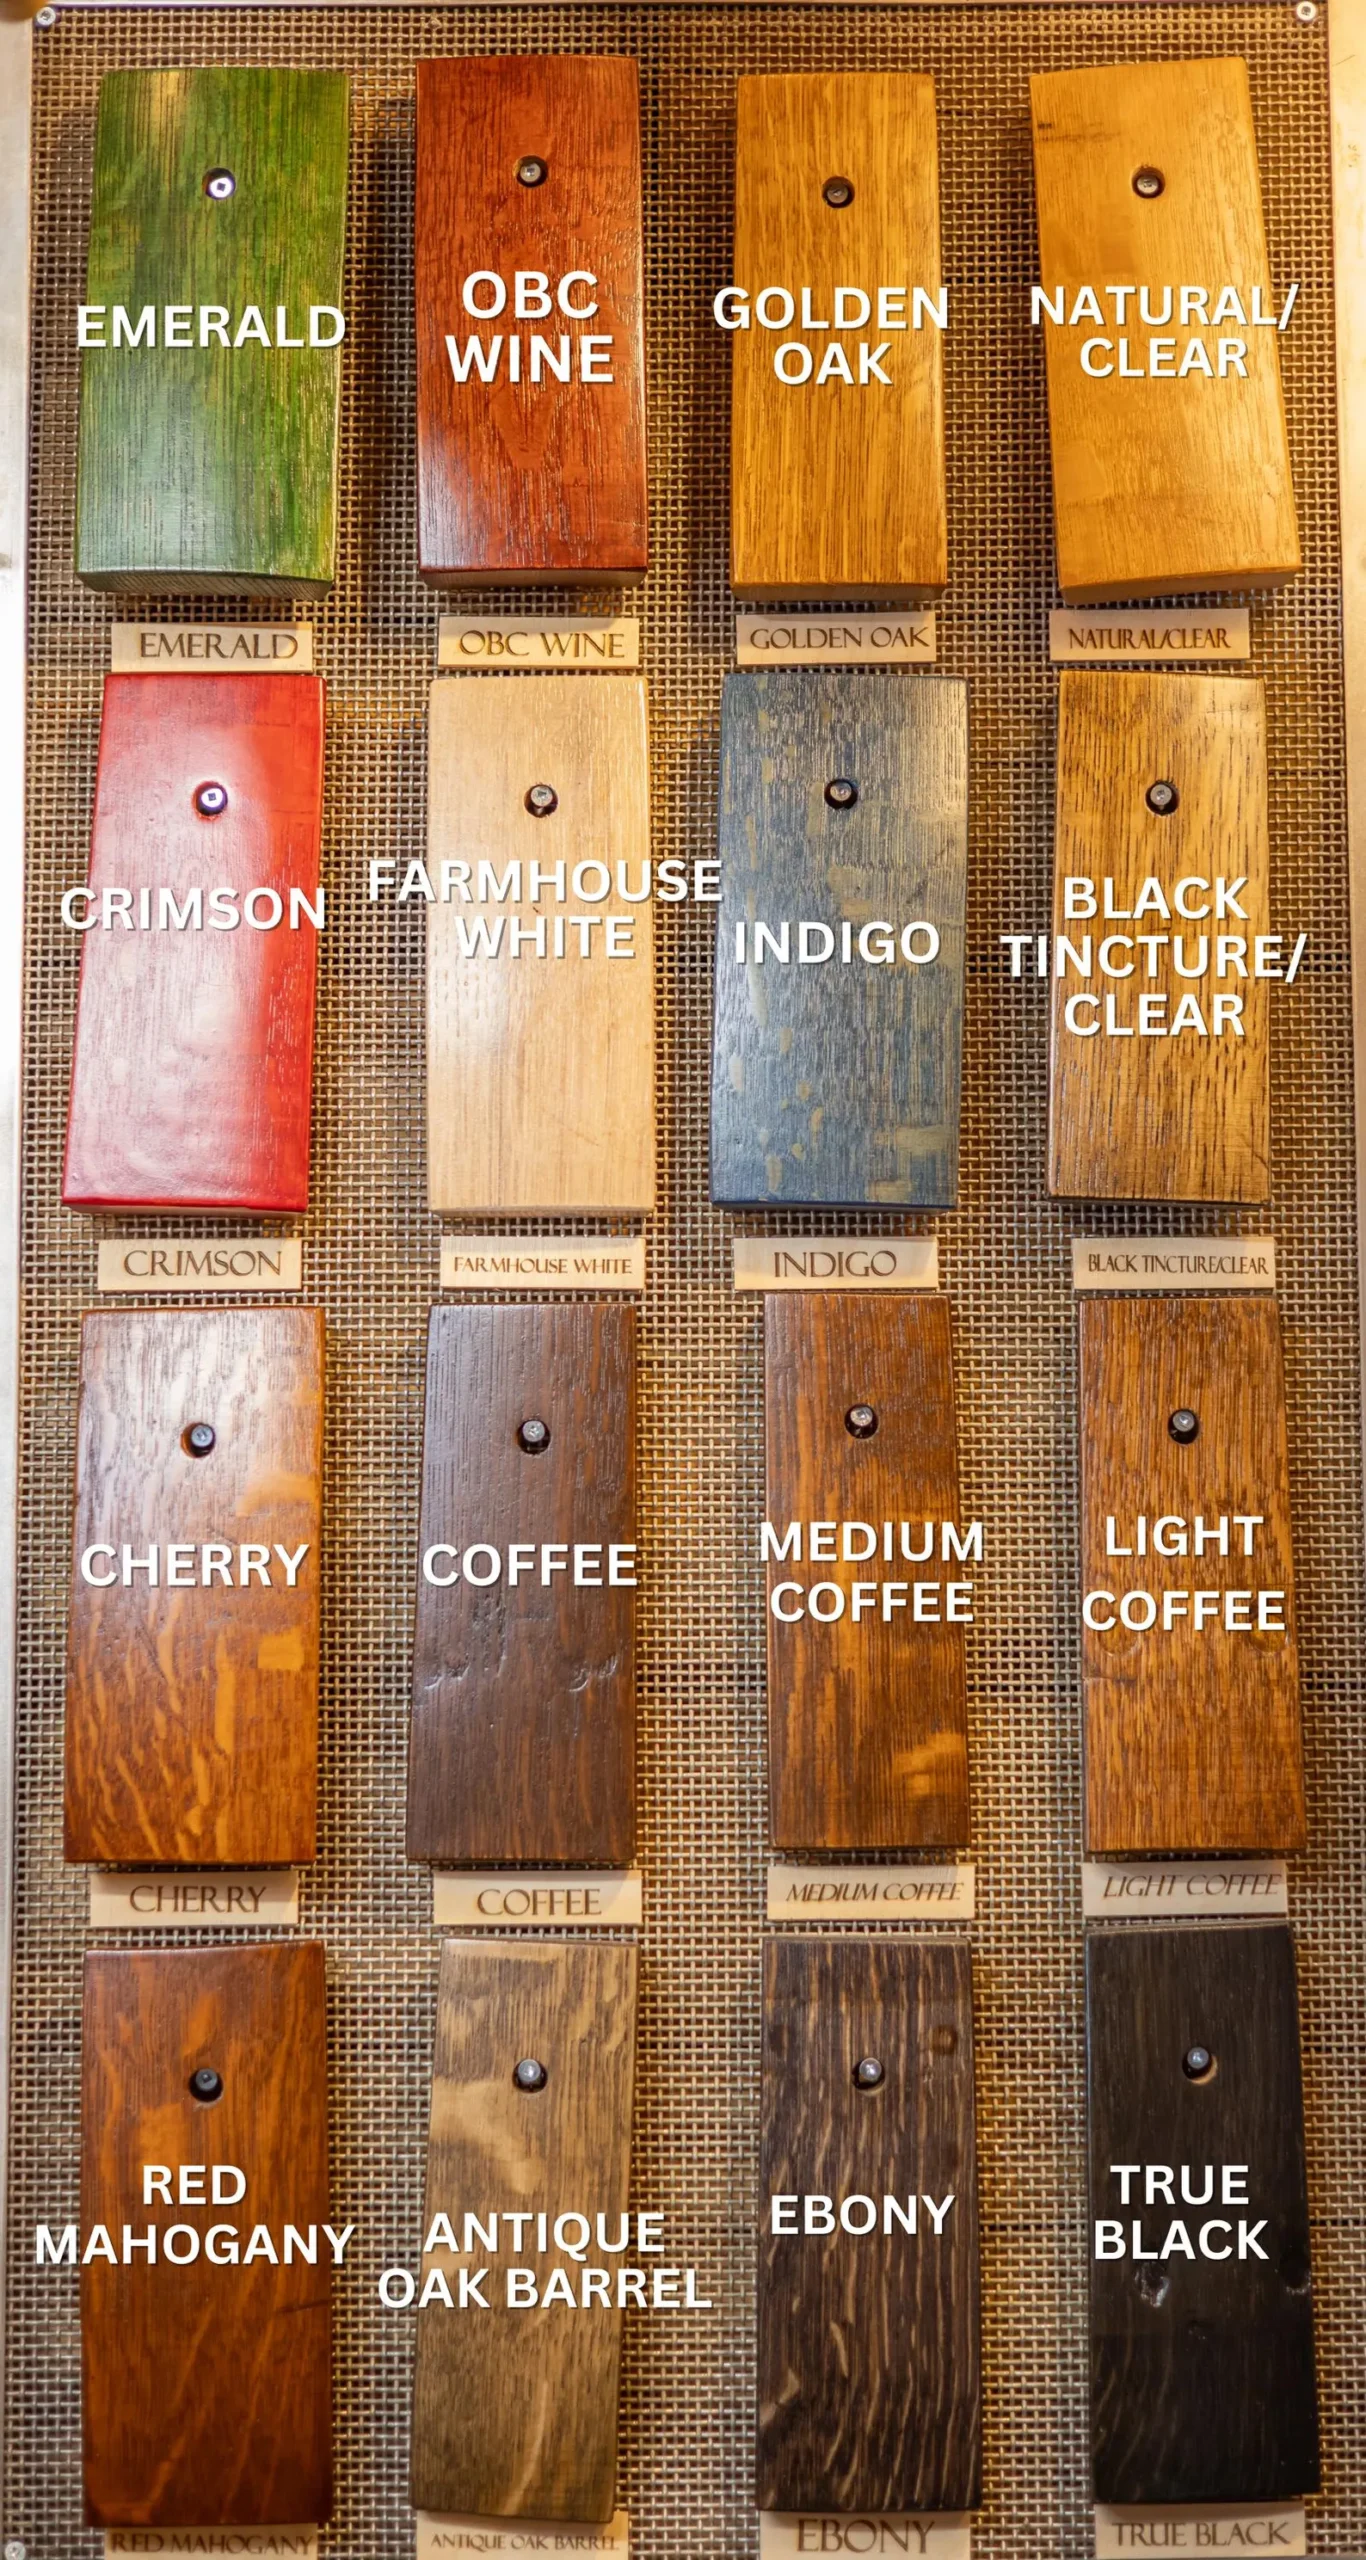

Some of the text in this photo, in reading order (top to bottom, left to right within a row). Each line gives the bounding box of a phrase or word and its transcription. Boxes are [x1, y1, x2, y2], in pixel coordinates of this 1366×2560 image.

[140, 633, 299, 660] EMERALD
[459, 630, 625, 659] OBC WINE
[749, 626, 930, 650] GOLDEN OAK
[1068, 627, 1231, 650] NATURAL/CLEAR
[124, 1250, 283, 1278] CRIMSON
[453, 1257, 633, 1275] FARMHOUSE WHITE
[774, 1249, 897, 1278] INDIGO
[1088, 1253, 1268, 1275] BLACK TINCTURE/CLEAR
[785, 1882, 965, 1902] MEDIUM COFFEE
[1103, 1873, 1281, 1898] LIGHT COFFEE
[129, 1885, 267, 1914] CHERRY
[476, 1888, 602, 1917] COFFEE
[110, 2533, 313, 2555] RED MAHOGANY
[431, 2534, 619, 2552] ANTIQUE OAK BARREL
[797, 2519, 936, 2554] EBONY
[1112, 2522, 1291, 2548] TRUE BLACK
